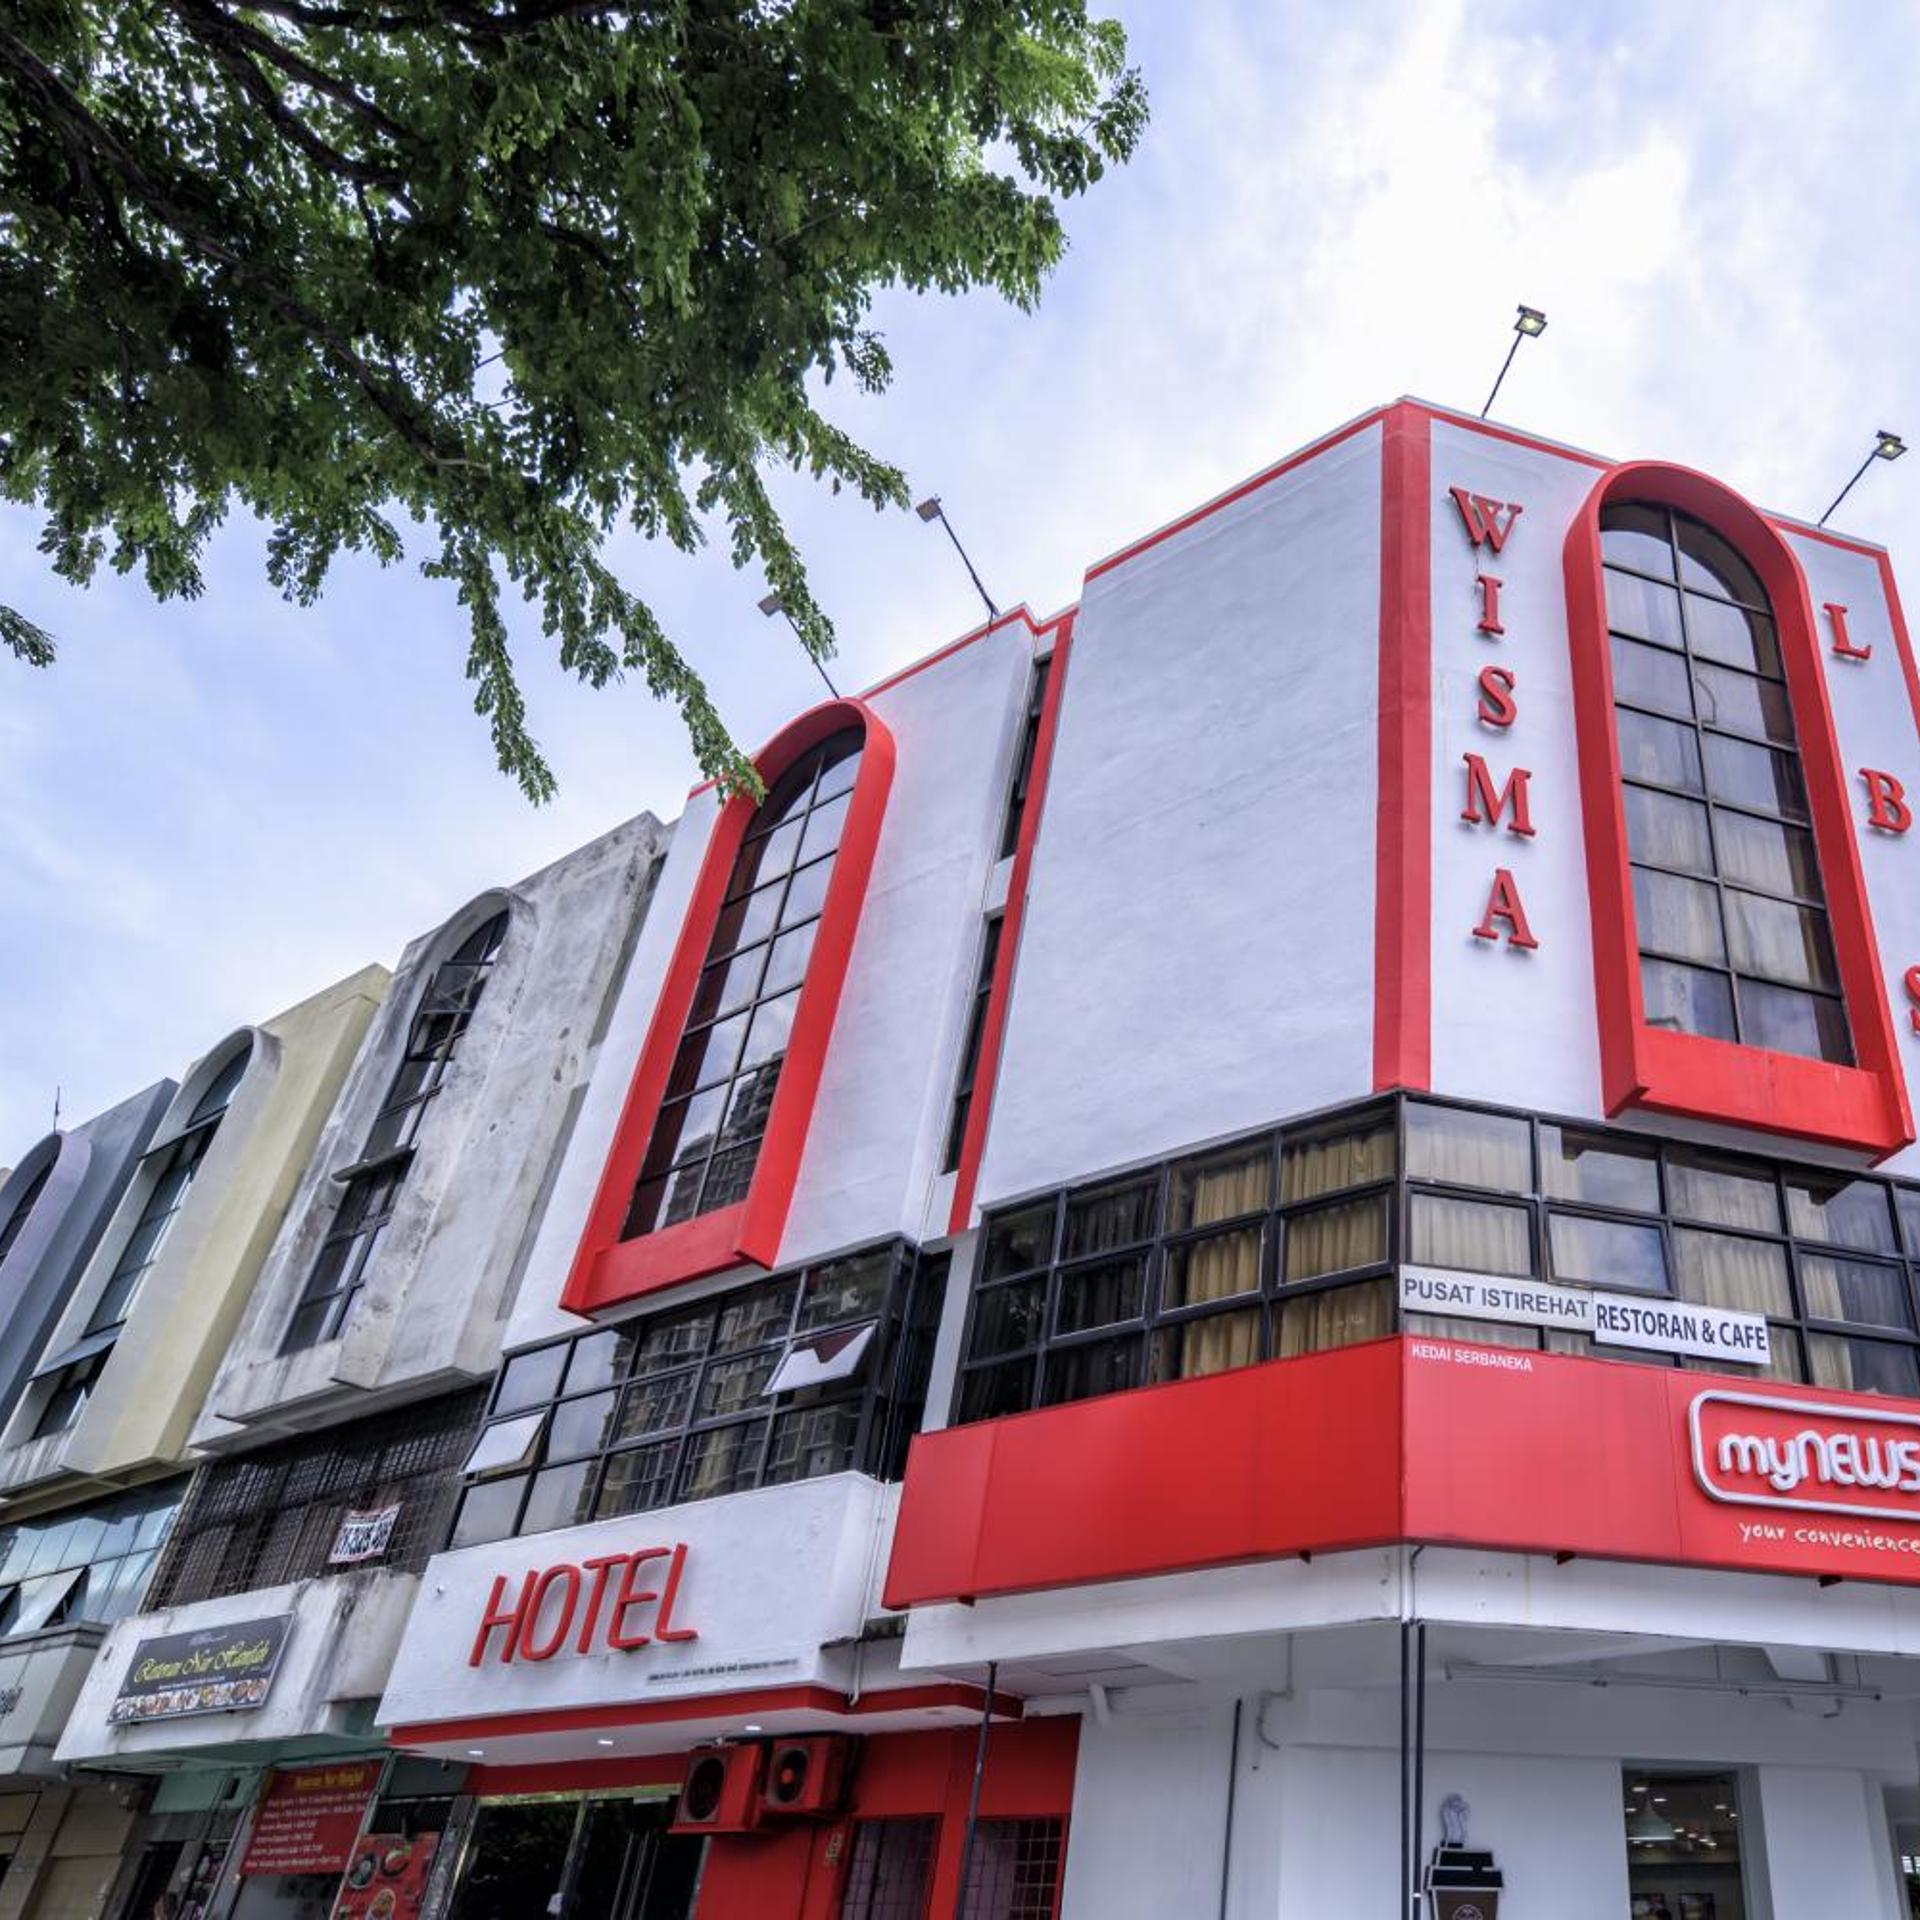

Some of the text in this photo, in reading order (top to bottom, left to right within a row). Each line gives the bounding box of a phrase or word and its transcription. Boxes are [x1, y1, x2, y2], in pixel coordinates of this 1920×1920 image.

[1449, 486, 1538, 949] WISMA
[1404, 1277, 1589, 1319] PUSAT ISTIREHAT
[1596, 1303, 1767, 1351] RESTORAN & CAFE
[1412, 1343, 1533, 1373] KEDAI SERBANEKA
[1739, 1522, 1786, 1543] your
[468, 1542, 699, 1668] HOTEL
